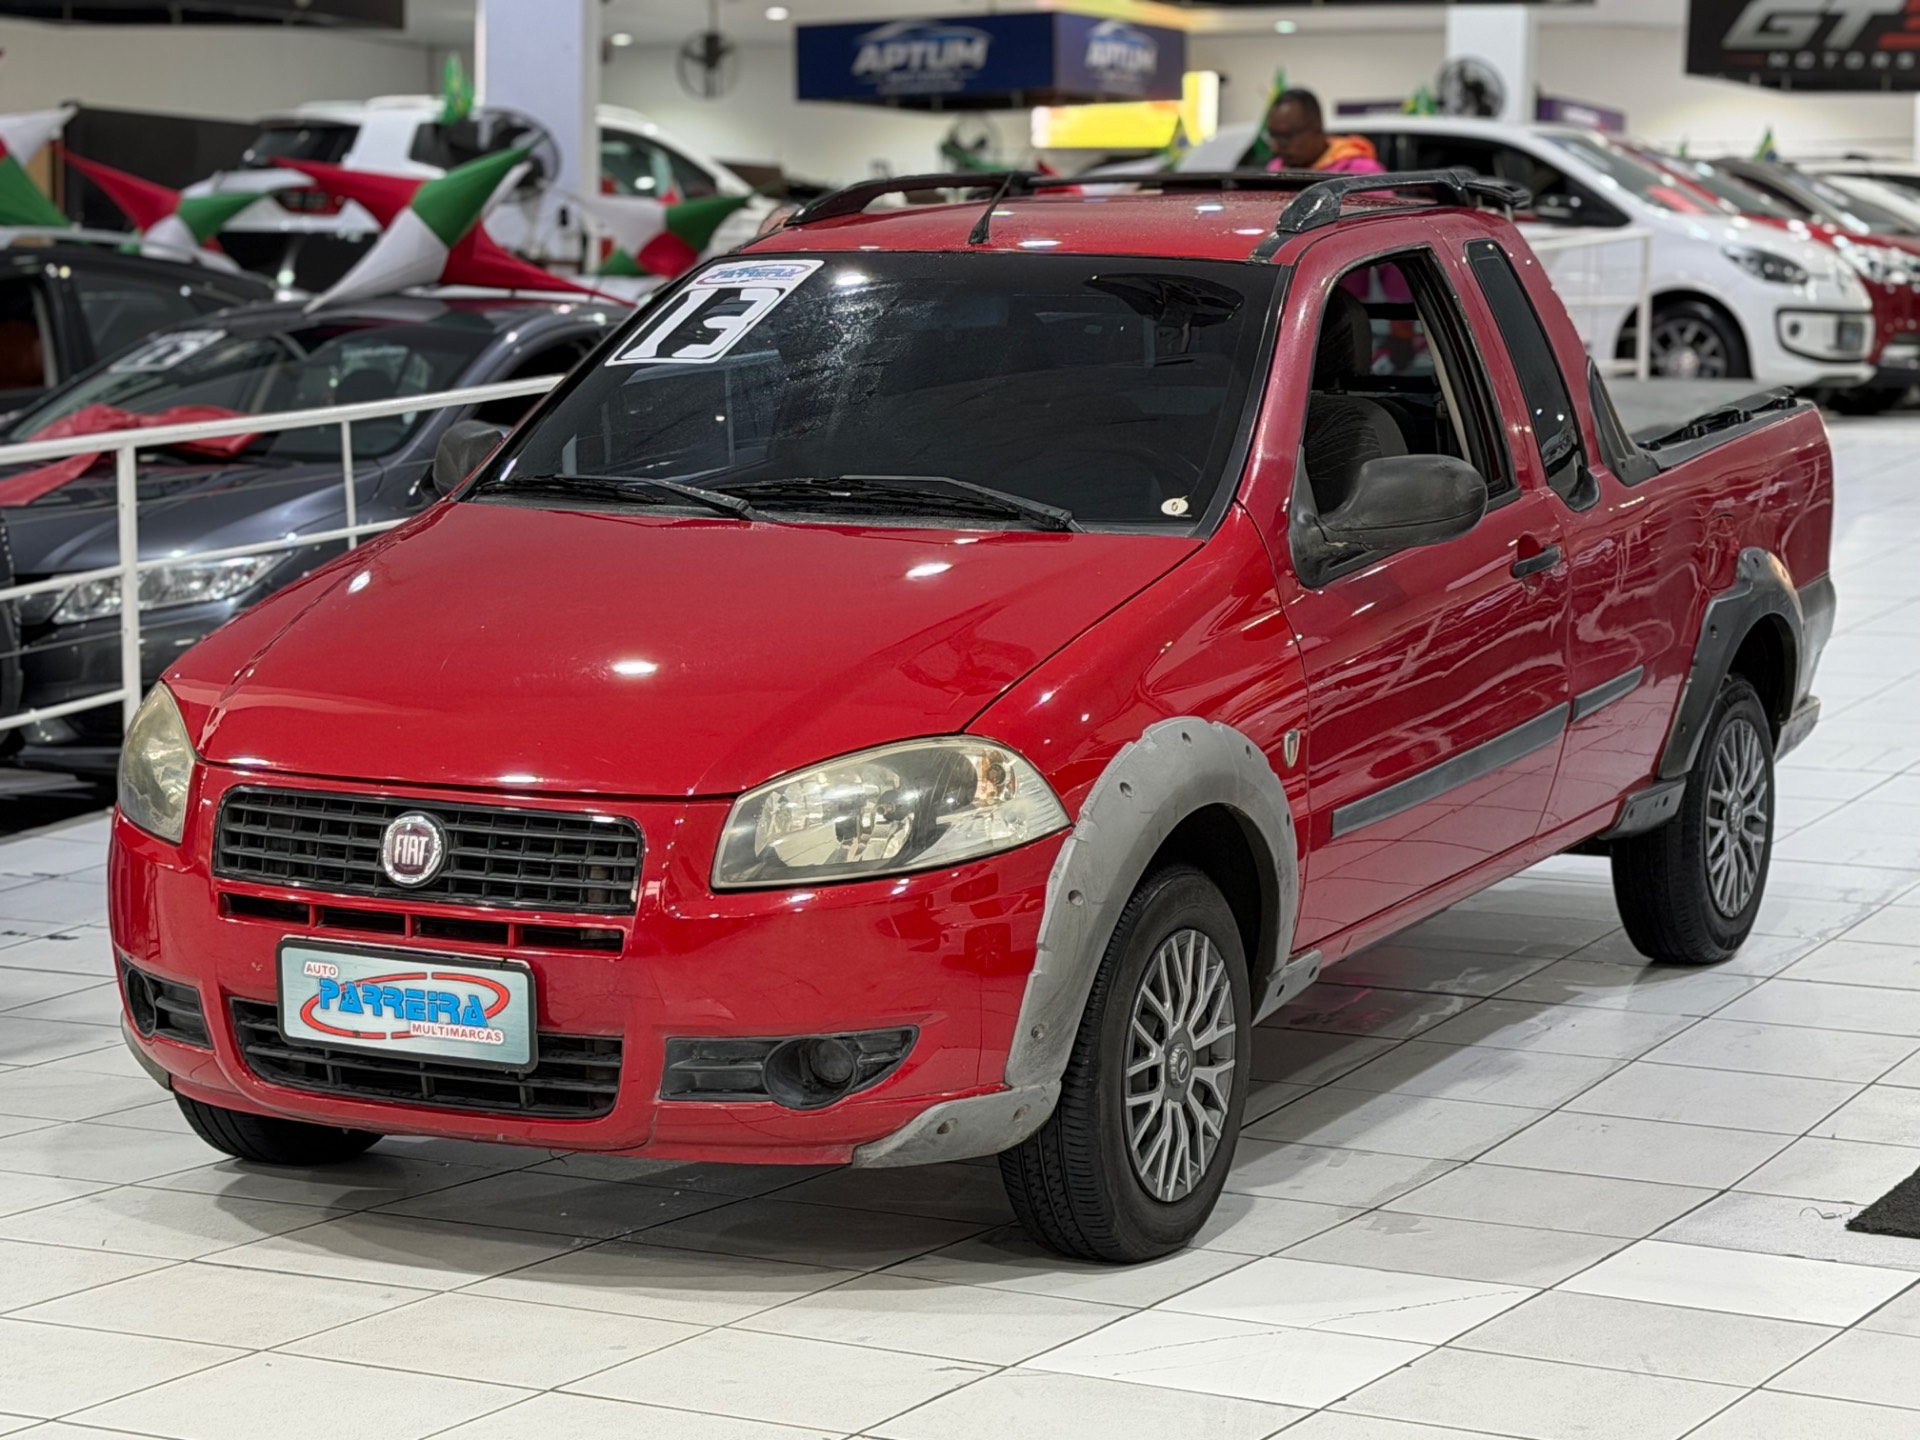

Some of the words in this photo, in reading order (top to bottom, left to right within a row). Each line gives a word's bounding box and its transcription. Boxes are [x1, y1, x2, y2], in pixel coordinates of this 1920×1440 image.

[852, 39, 989, 75] APTUM
[1085, 40, 1157, 71] APTUM
[621, 288, 780, 360] 13
[394, 834, 429, 866] FIAT
[305, 963, 337, 977] AUTO
[319, 978, 489, 1027] PARREIRA
[412, 1023, 502, 1042] MULTIMARCAS
